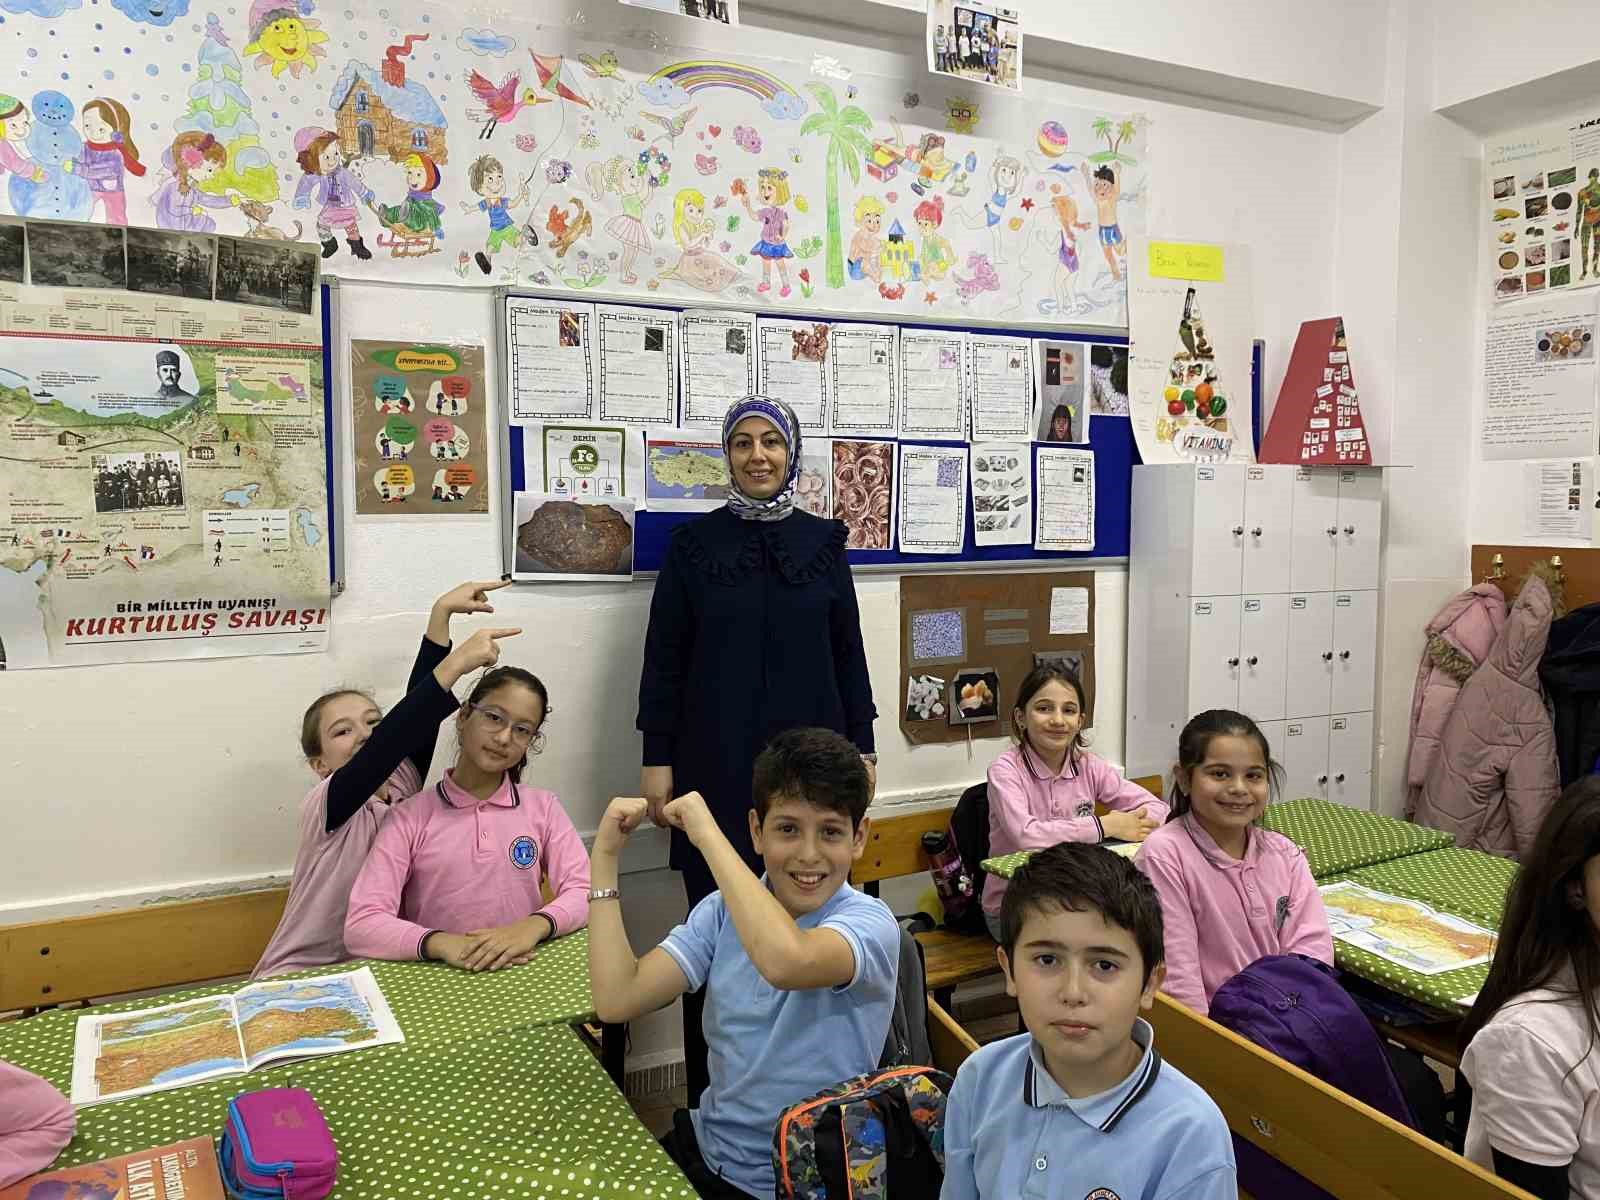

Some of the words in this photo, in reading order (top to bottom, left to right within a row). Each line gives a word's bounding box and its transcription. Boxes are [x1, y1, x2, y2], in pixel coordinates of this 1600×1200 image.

[577, 449, 594, 462] Fe
[116, 600, 142, 613] BİR
[147, 598, 212, 612] MİLLETİN
[217, 598, 276, 610] UYANIŞI
[66, 612, 218, 636] KURTULUŞ
[228, 608, 326, 631] SAVAŞI
